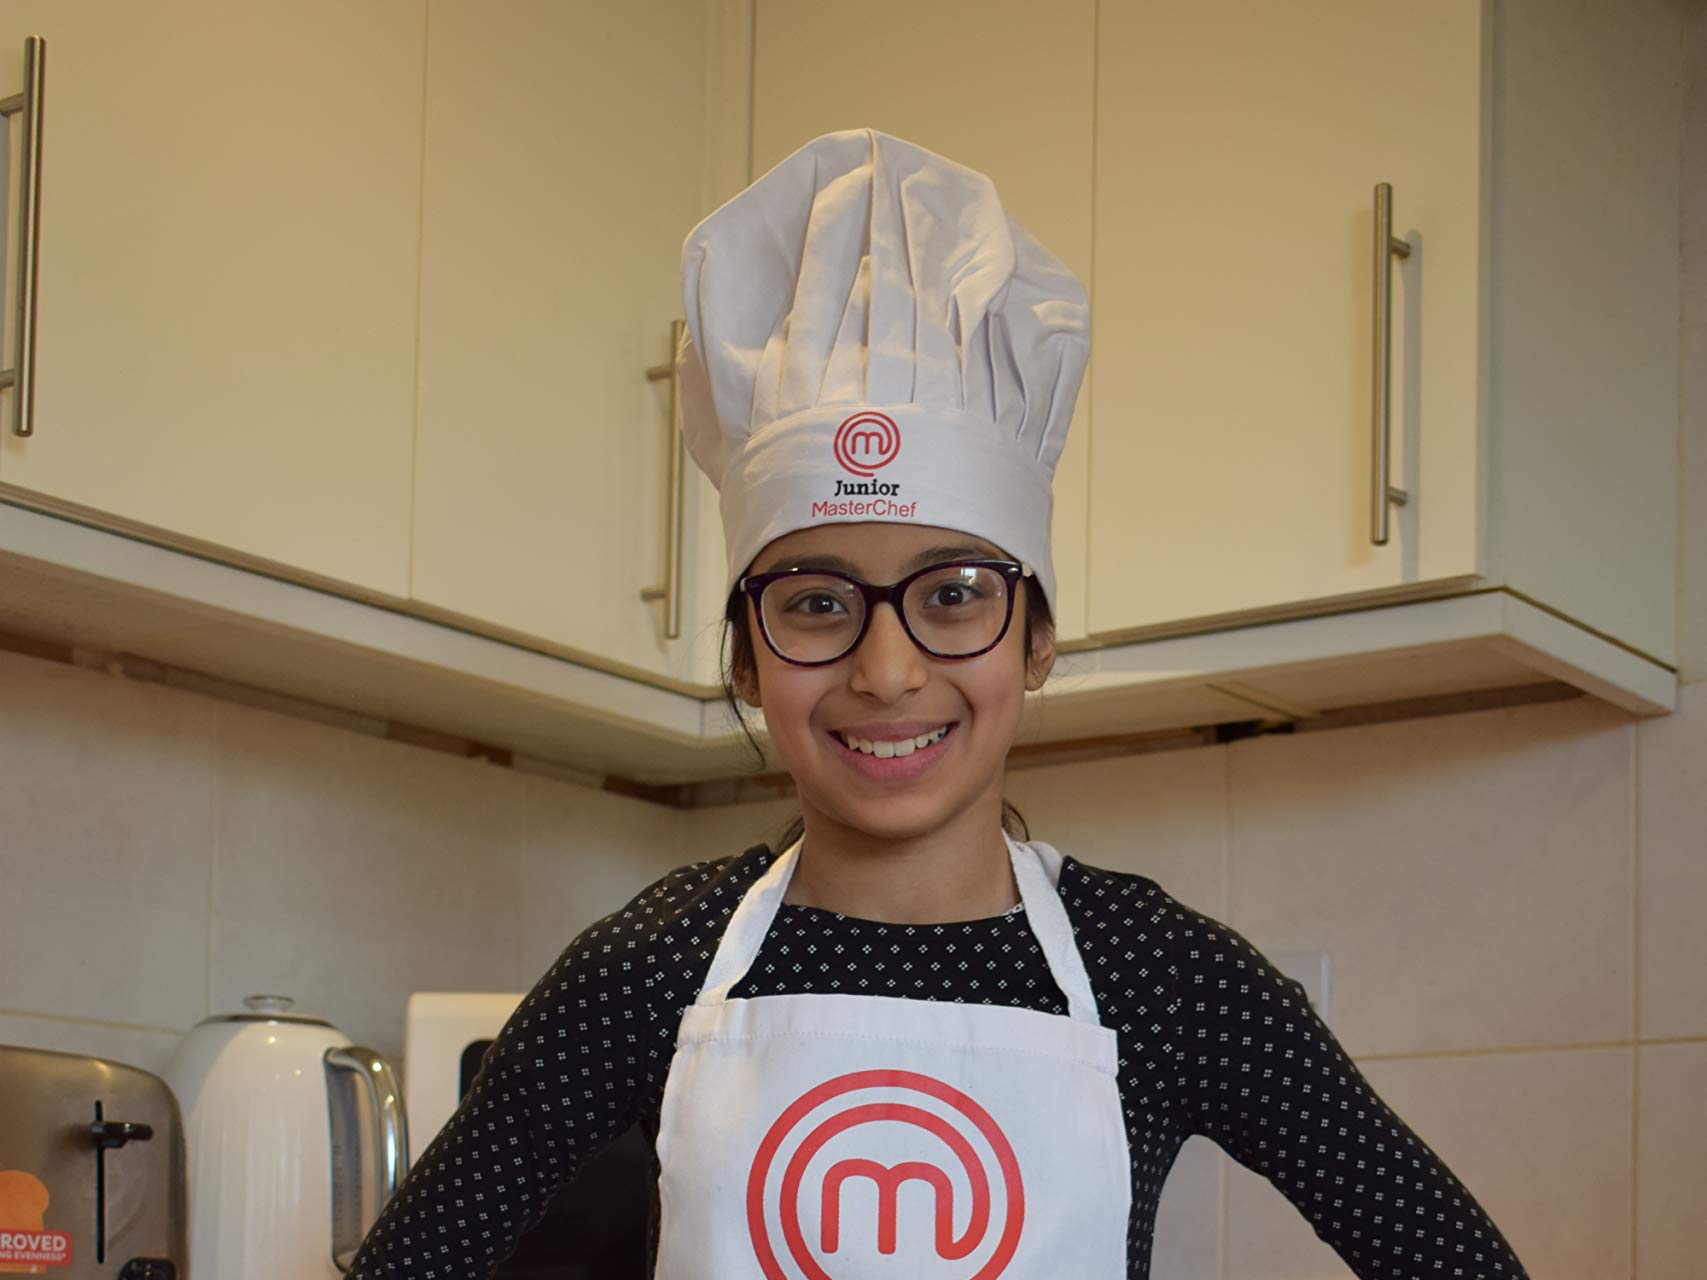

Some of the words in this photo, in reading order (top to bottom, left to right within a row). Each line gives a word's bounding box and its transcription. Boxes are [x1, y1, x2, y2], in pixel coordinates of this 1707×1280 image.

[834, 478, 900, 497] Junior
[811, 499, 917, 518] MasterChef
[0, 1233, 67, 1252] ROVED
